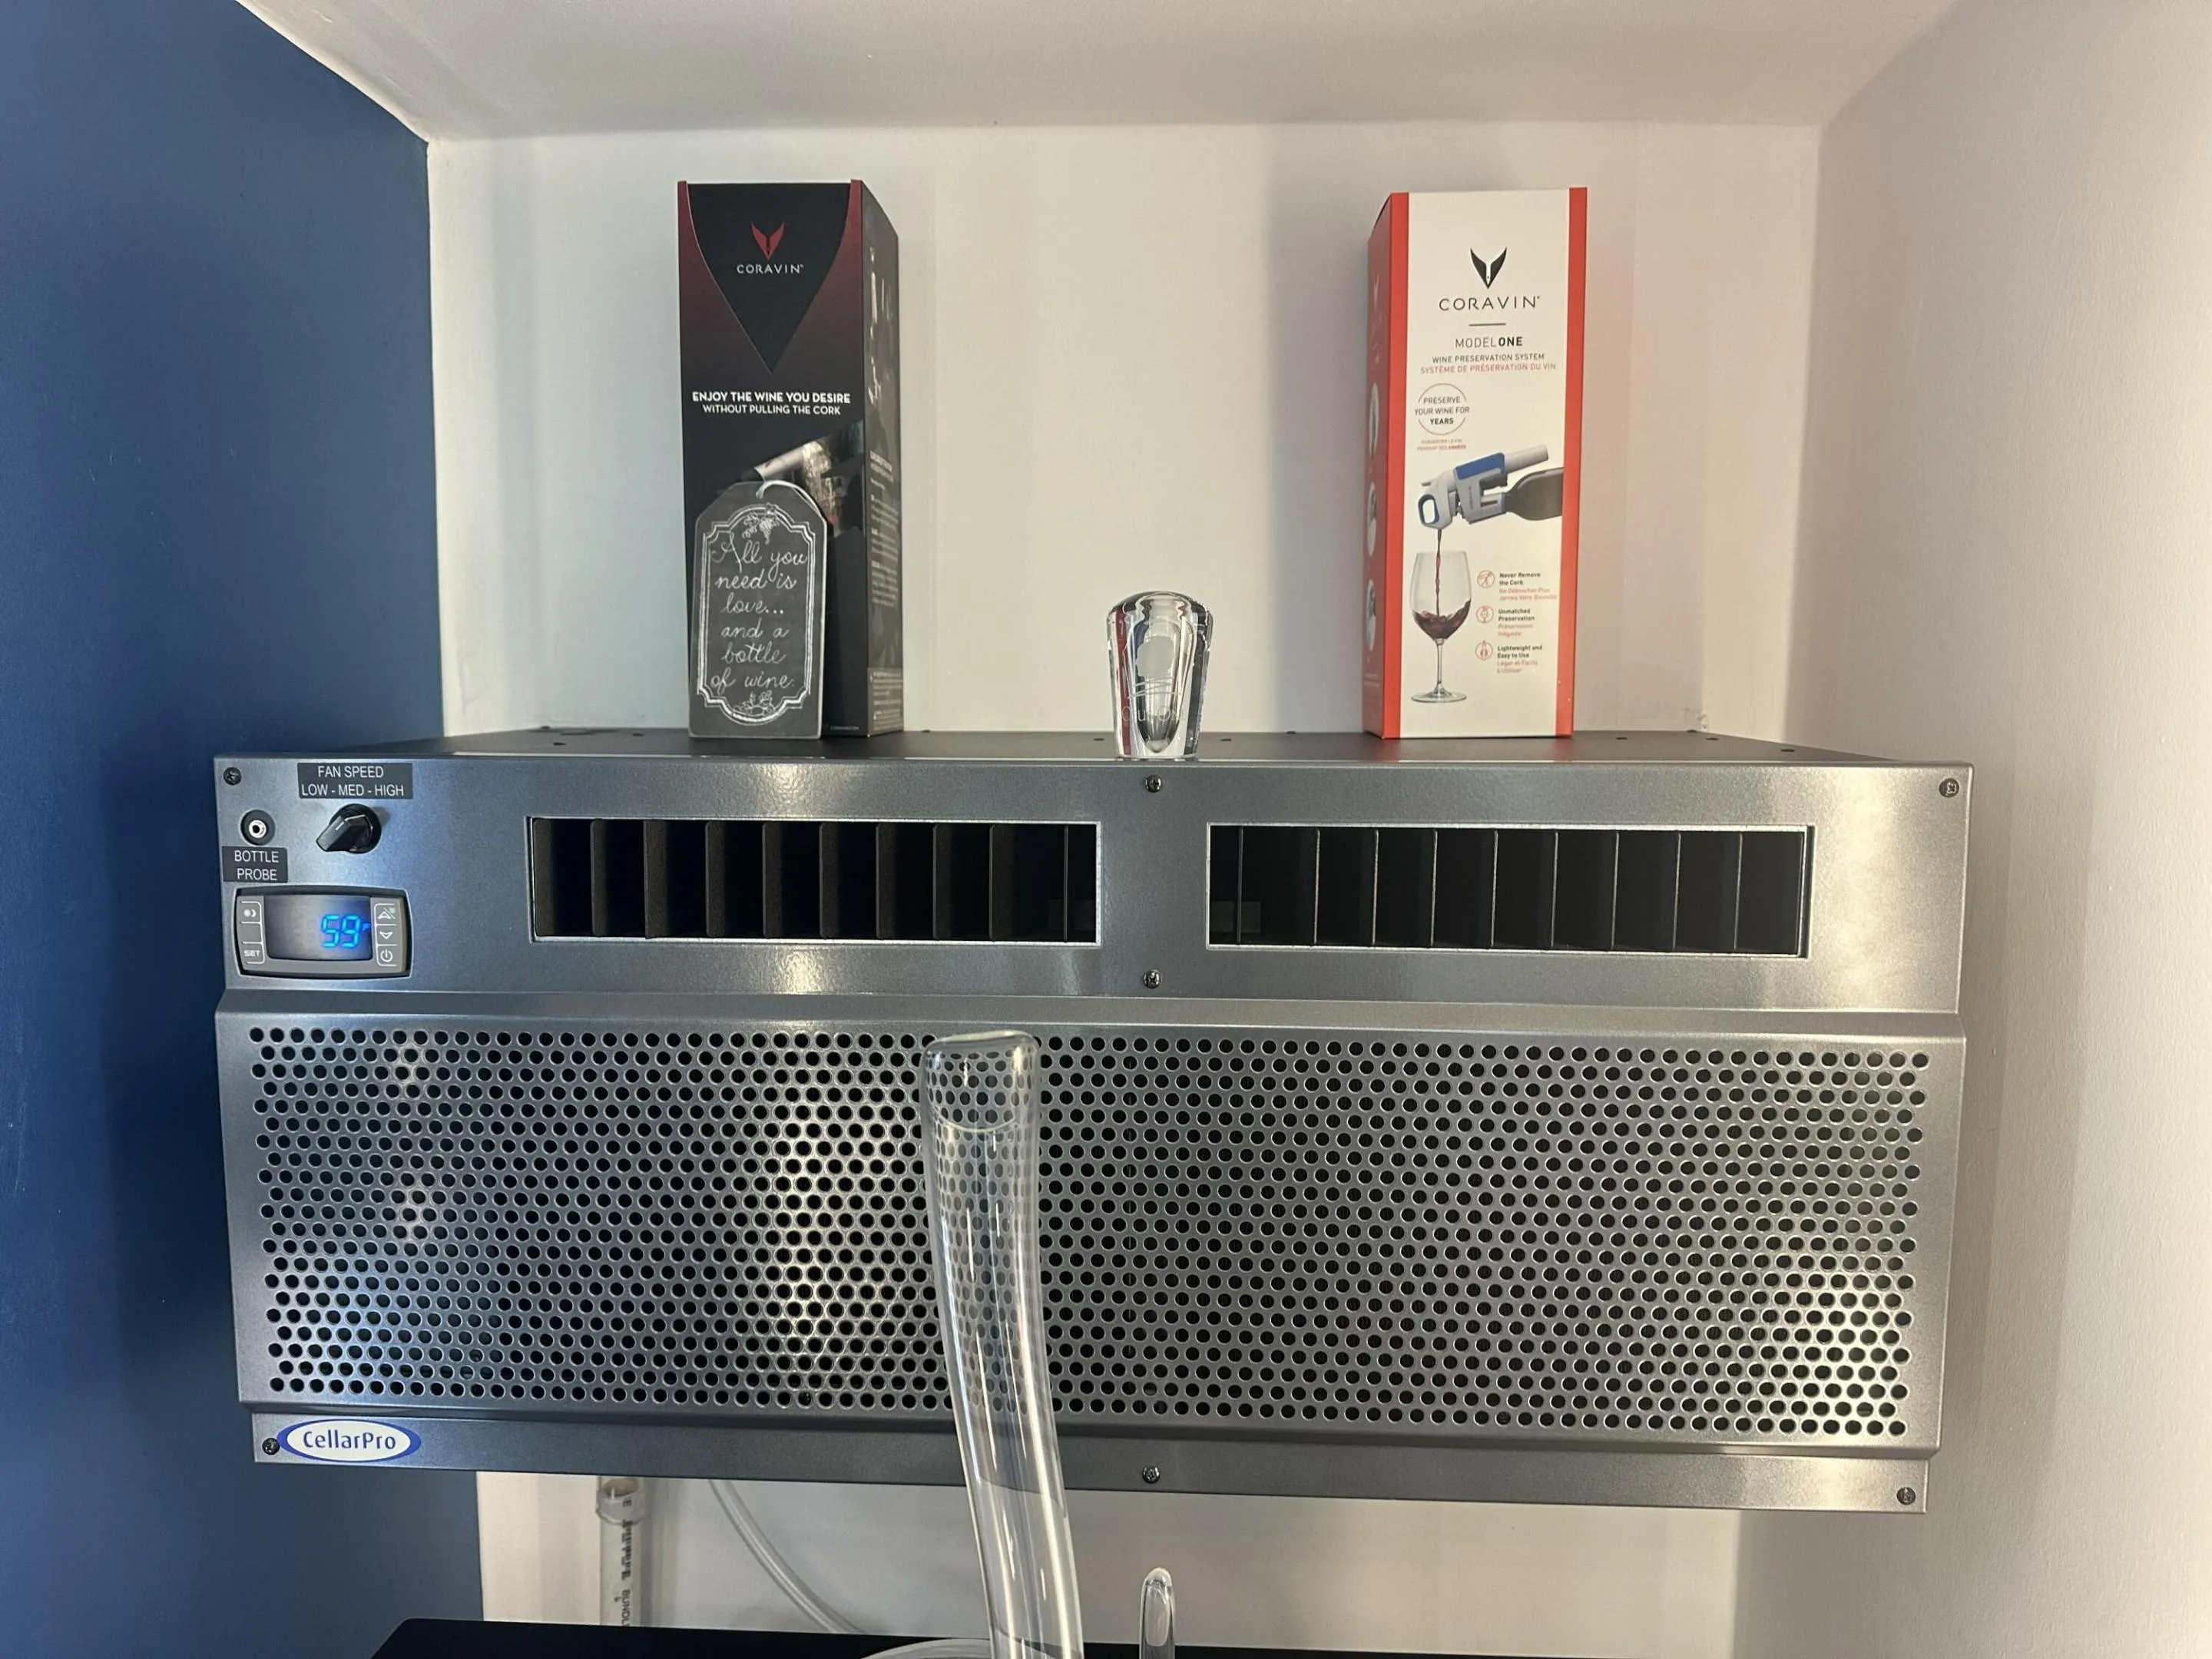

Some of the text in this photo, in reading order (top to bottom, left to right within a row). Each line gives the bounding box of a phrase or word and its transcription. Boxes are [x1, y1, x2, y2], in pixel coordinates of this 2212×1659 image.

[737, 263, 800, 274] CORAVIN
[1439, 296, 1535, 311] CORAVIN
[1455, 354, 1512, 363] PRESERVATION
[1420, 365, 1455, 374] SYSTÈME
[1469, 363, 1528, 372] PRÉSERVATION
[692, 392, 851, 403] ENJOY THE WINE YOU DESIRE
[702, 404, 841, 415] WITHOUT PULLING THE CORK
[711, 531, 808, 581] All you
[715, 568, 797, 590] need is
[720, 618, 789, 638] and a
[720, 642, 786, 664] bottle
[710, 667, 737, 694] of
[318, 766, 383, 778] FAN SPEED
[301, 784, 328, 796] LOW
[339, 784, 365, 796] MED
[375, 784, 404, 796] HIGH
[234, 850, 279, 863] BOTTLE
[237, 868, 277, 881] PROBE
[322, 915, 360, 947] 59
[303, 1429, 396, 1449] CellarPro
